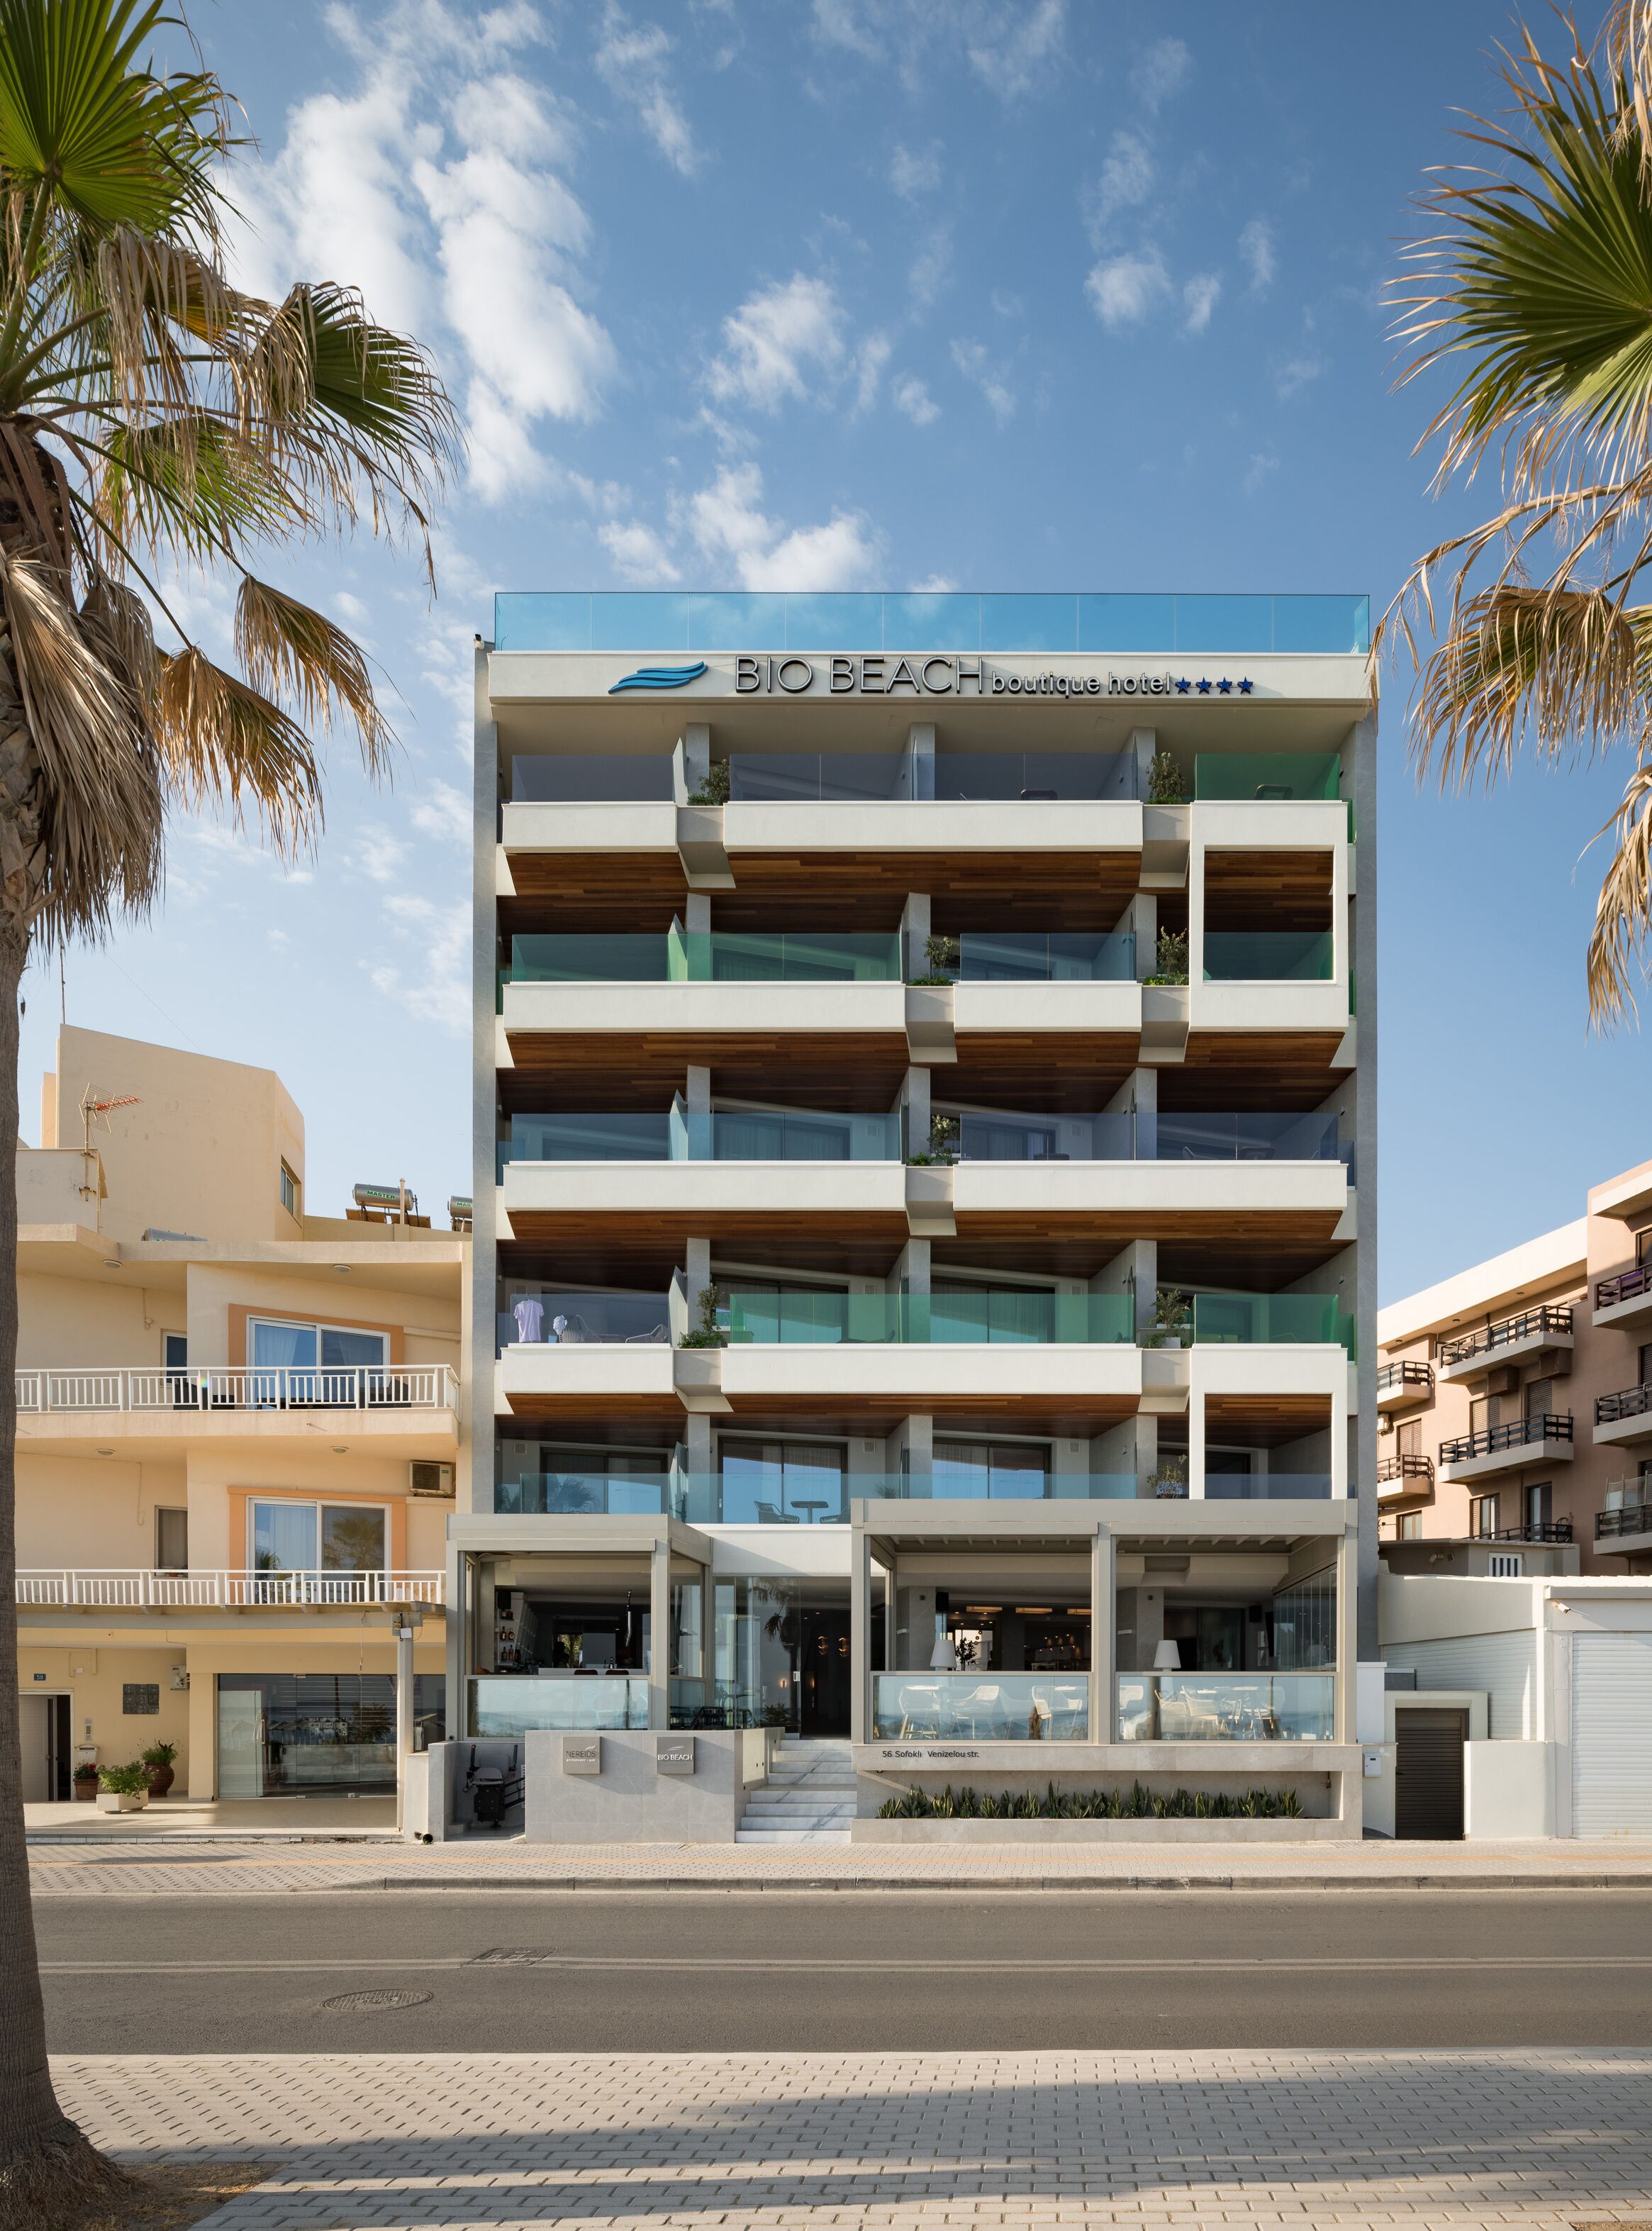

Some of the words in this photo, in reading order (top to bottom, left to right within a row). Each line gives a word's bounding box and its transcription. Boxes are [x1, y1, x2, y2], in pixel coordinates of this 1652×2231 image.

[735, 656, 813, 694] BIO
[830, 656, 983, 694] BEACH
[992, 672, 1100, 699] boutique
[1108, 672, 1171, 695] hotel
[367, 1191, 396, 1200] MASTER
